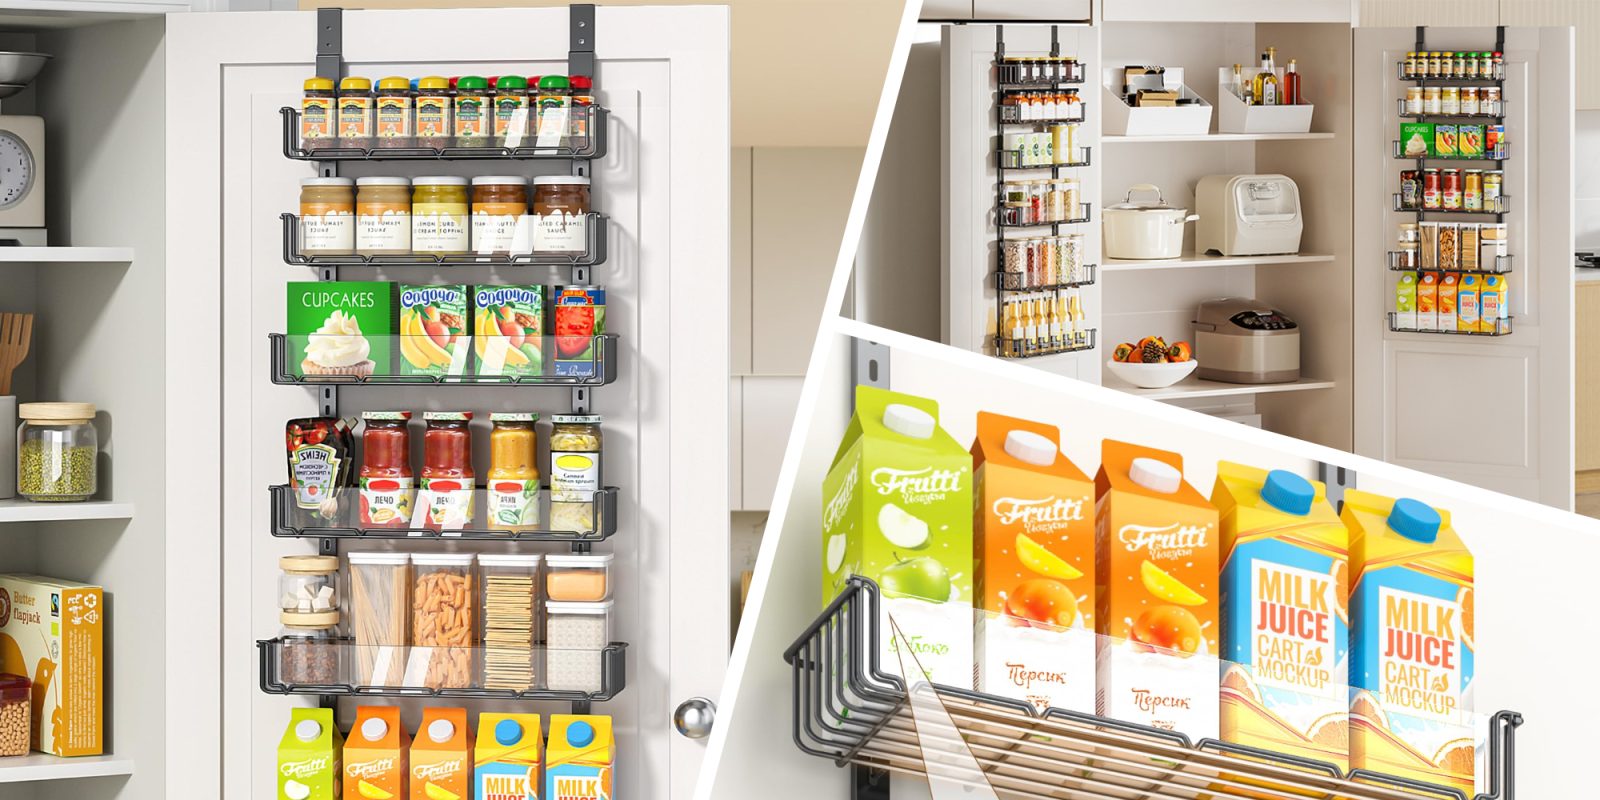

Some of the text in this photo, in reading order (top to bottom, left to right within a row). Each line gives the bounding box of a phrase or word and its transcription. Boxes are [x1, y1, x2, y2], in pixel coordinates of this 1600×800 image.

[302, 291, 375, 308] CUPCAKES
[870, 465, 968, 496] Frutti
[374, 496, 394, 505] ЛЕЧО
[992, 495, 1090, 526] Frutti
[1118, 521, 1214, 552] Frutti
[13, 591, 36, 606] Butter
[1257, 567, 1330, 613] MILK
[13, 607, 41, 625] flapjack
[1256, 600, 1329, 644] JUICE
[1385, 594, 1455, 641] MILK
[1257, 633, 1305, 664] CART
[1384, 627, 1455, 670] JUICE
[1005, 661, 1067, 690] Персик
[1257, 656, 1330, 690] MOCKUP
[1384, 660, 1431, 691] CART
[1131, 687, 1192, 715] Персик
[1384, 683, 1456, 716] MOCKUP
[280, 756, 330, 777] Frutti
[346, 756, 398, 777] Frutti
[413, 758, 464, 780] Frutti
[486, 777, 526, 795] MILK
[557, 779, 598, 797] MILK
